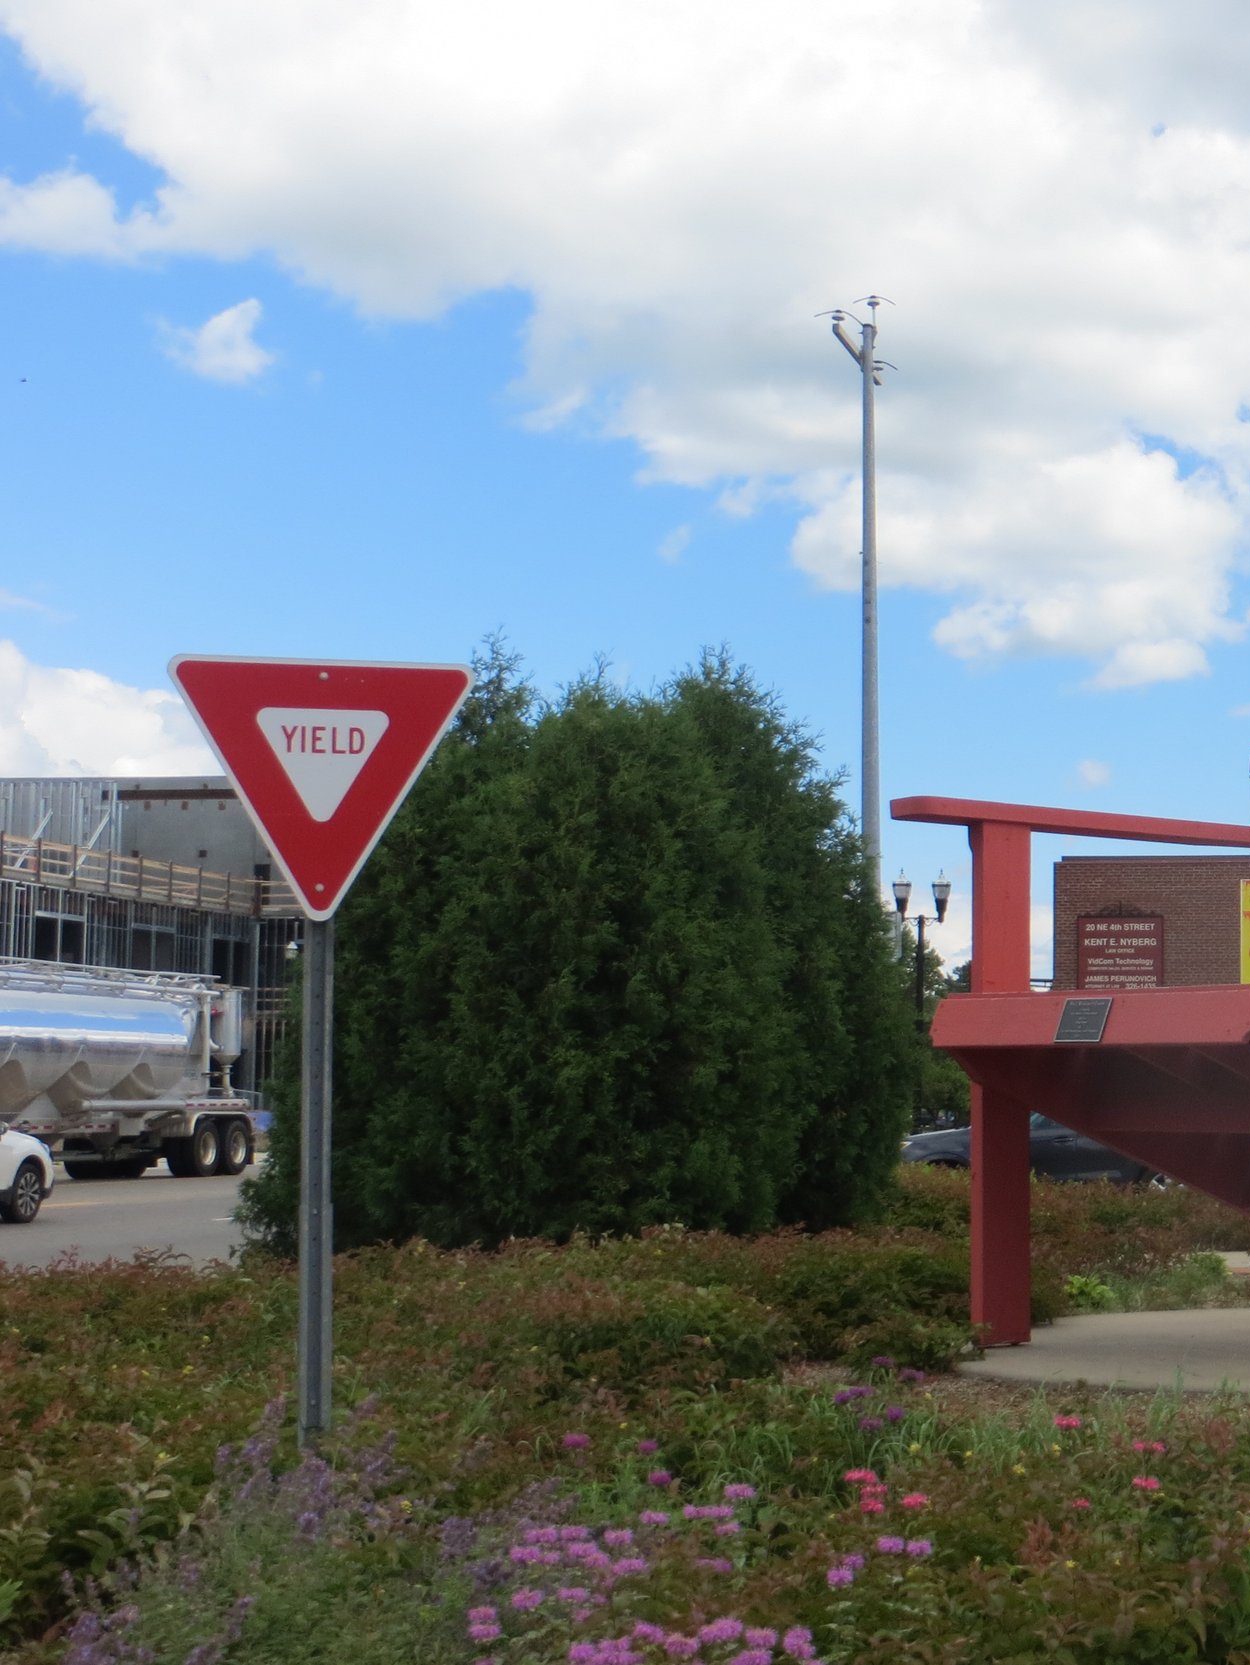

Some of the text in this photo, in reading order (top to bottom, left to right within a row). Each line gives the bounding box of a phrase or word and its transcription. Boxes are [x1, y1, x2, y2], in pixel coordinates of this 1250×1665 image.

[281, 725, 366, 755] YIELD
[1086, 923, 1155, 931] 20 NE 4th STREET
[1084, 938, 1157, 946] KENT E. NYBERG
[1115, 957, 1154, 966] Technology
